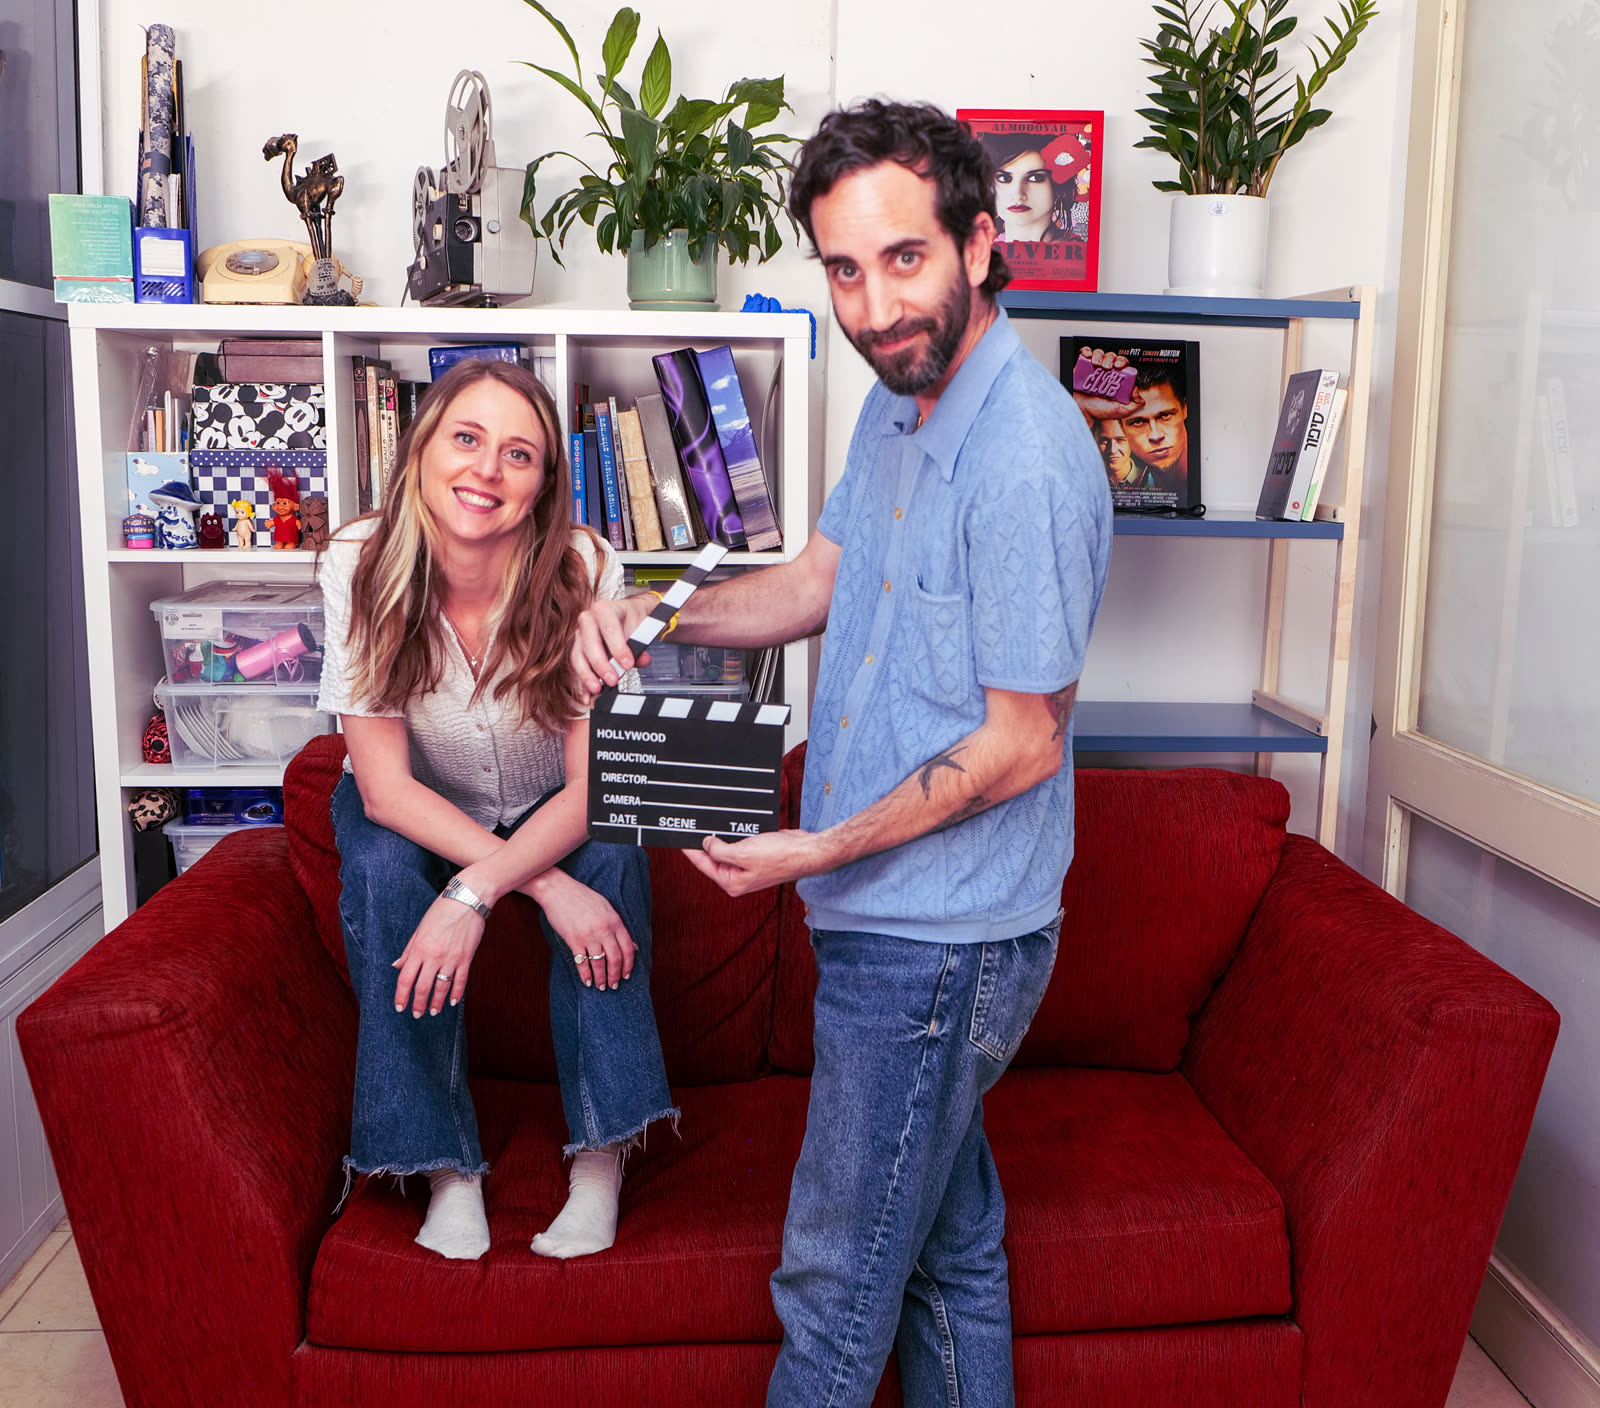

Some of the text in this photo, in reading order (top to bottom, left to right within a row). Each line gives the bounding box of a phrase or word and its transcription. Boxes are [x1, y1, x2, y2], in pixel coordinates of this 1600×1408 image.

[1130, 348, 1141, 356] PITT
[1093, 367, 1126, 385] FIGHT
[1082, 373, 1121, 397] CLUB
[1303, 411, 1325, 451] סיפור
[596, 728, 667, 743] HOLLYWOOD
[596, 751, 657, 764] PRODUCTION
[601, 772, 648, 785] DIRECTOR
[602, 793, 642, 806] CAMERA
[609, 813, 760, 834] DATE SCENE TAKE
